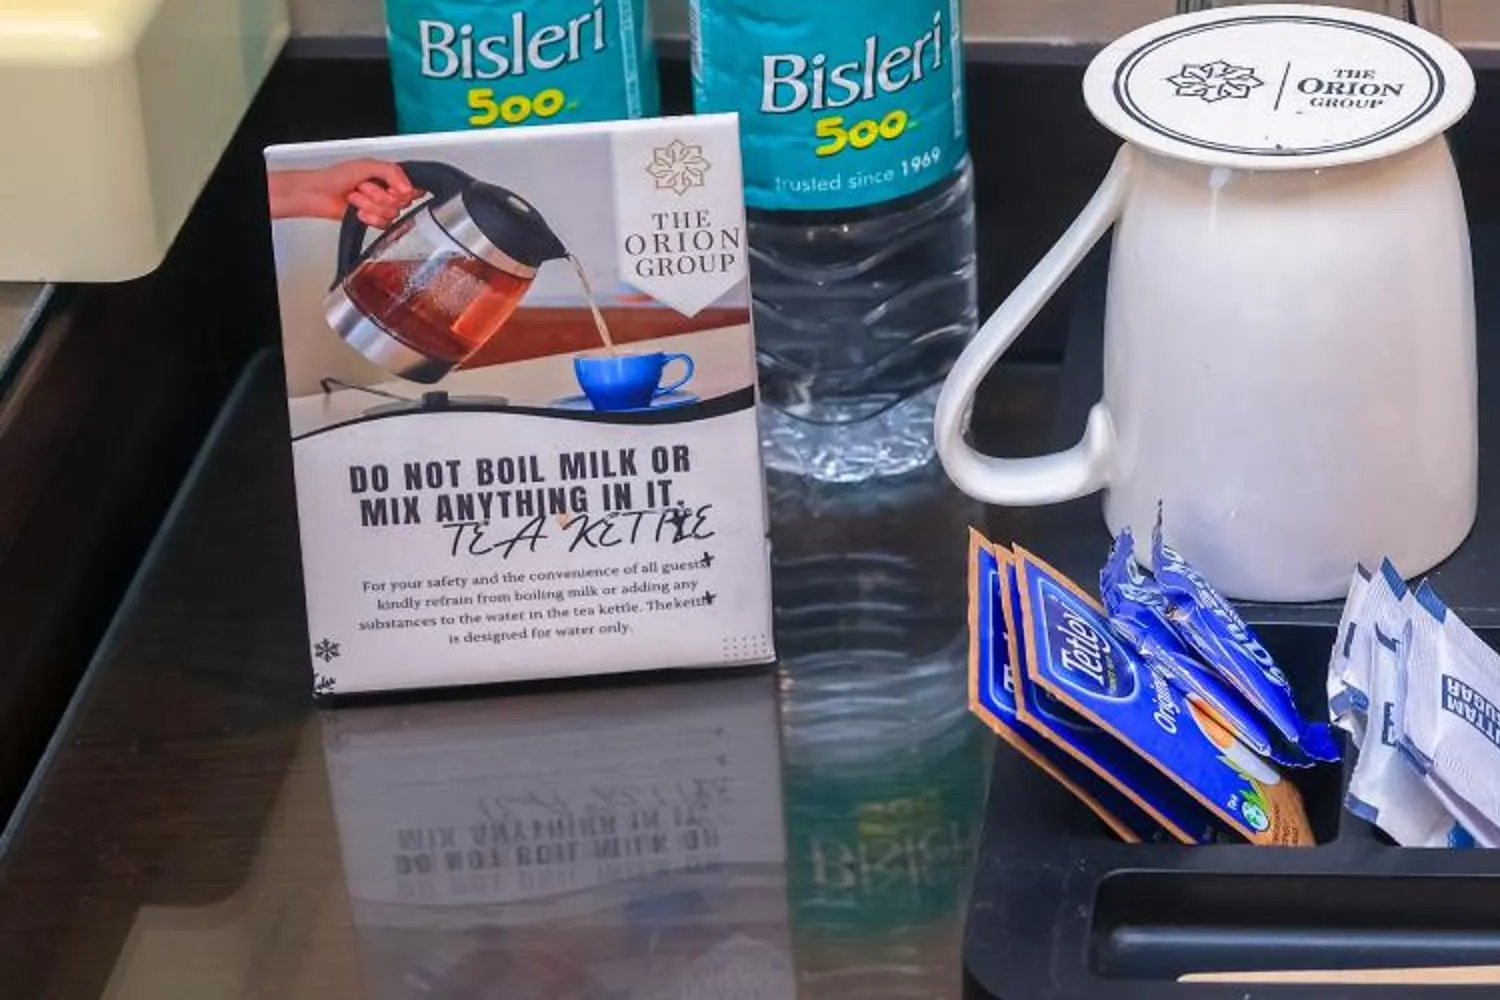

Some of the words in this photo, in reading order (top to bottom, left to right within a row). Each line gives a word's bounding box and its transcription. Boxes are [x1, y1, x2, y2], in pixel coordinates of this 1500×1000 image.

[760, 9, 942, 114] Bisleri
[1333, 69, 1376, 79] THE
[1297, 77, 1404, 97] ORION
[1309, 97, 1383, 109] GROUP
[467, 87, 565, 126] 500
[815, 108, 909, 158] 500
[775, 171, 841, 193] trusted
[848, 168, 895, 190] since
[901, 145, 942, 177] 1969
[651, 209, 711, 230] THE
[625, 226, 740, 256] ORION
[636, 253, 735, 278] GROUP
[349, 464, 389, 494] DO
[403, 459, 461, 490] NOT
[476, 454, 545, 487] BOIL
[559, 447, 638, 481] MILK
[651, 444, 691, 474] OR
[360, 495, 420, 527] MIX
[435, 486, 589, 523] ANYTHING
[602, 482, 633, 512] IN
[361, 581, 387, 593] For
[390, 580, 424, 593] your
[426, 575, 469, 589] safety
[472, 572, 499, 584] and
[502, 571, 526, 583] the
[529, 565, 619, 582] convenience
[624, 562, 640, 574] of
[642, 561, 658, 573] all
[377, 597, 421, 611] kindly
[425, 594, 473, 608] refrain
[477, 591, 511, 604] from
[514, 586, 564, 602] boiling
[568, 585, 600, 598] milk
[602, 586, 617, 597] or
[621, 580, 670, 595] adding
[673, 579, 699, 592] any
[358, 616, 437, 631] substances
[441, 614, 455, 626] to
[459, 612, 483, 625] the
[485, 610, 526, 623] water
[529, 608, 544, 620] in
[547, 605, 569, 618] the
[573, 605, 597, 617] tea
[599, 601, 642, 616] kettle.
[449, 633, 460, 645] is
[464, 627, 527, 645] designed
[531, 626, 552, 640] for
[555, 624, 596, 638] water
[1057, 606, 1111, 686] Tetley
